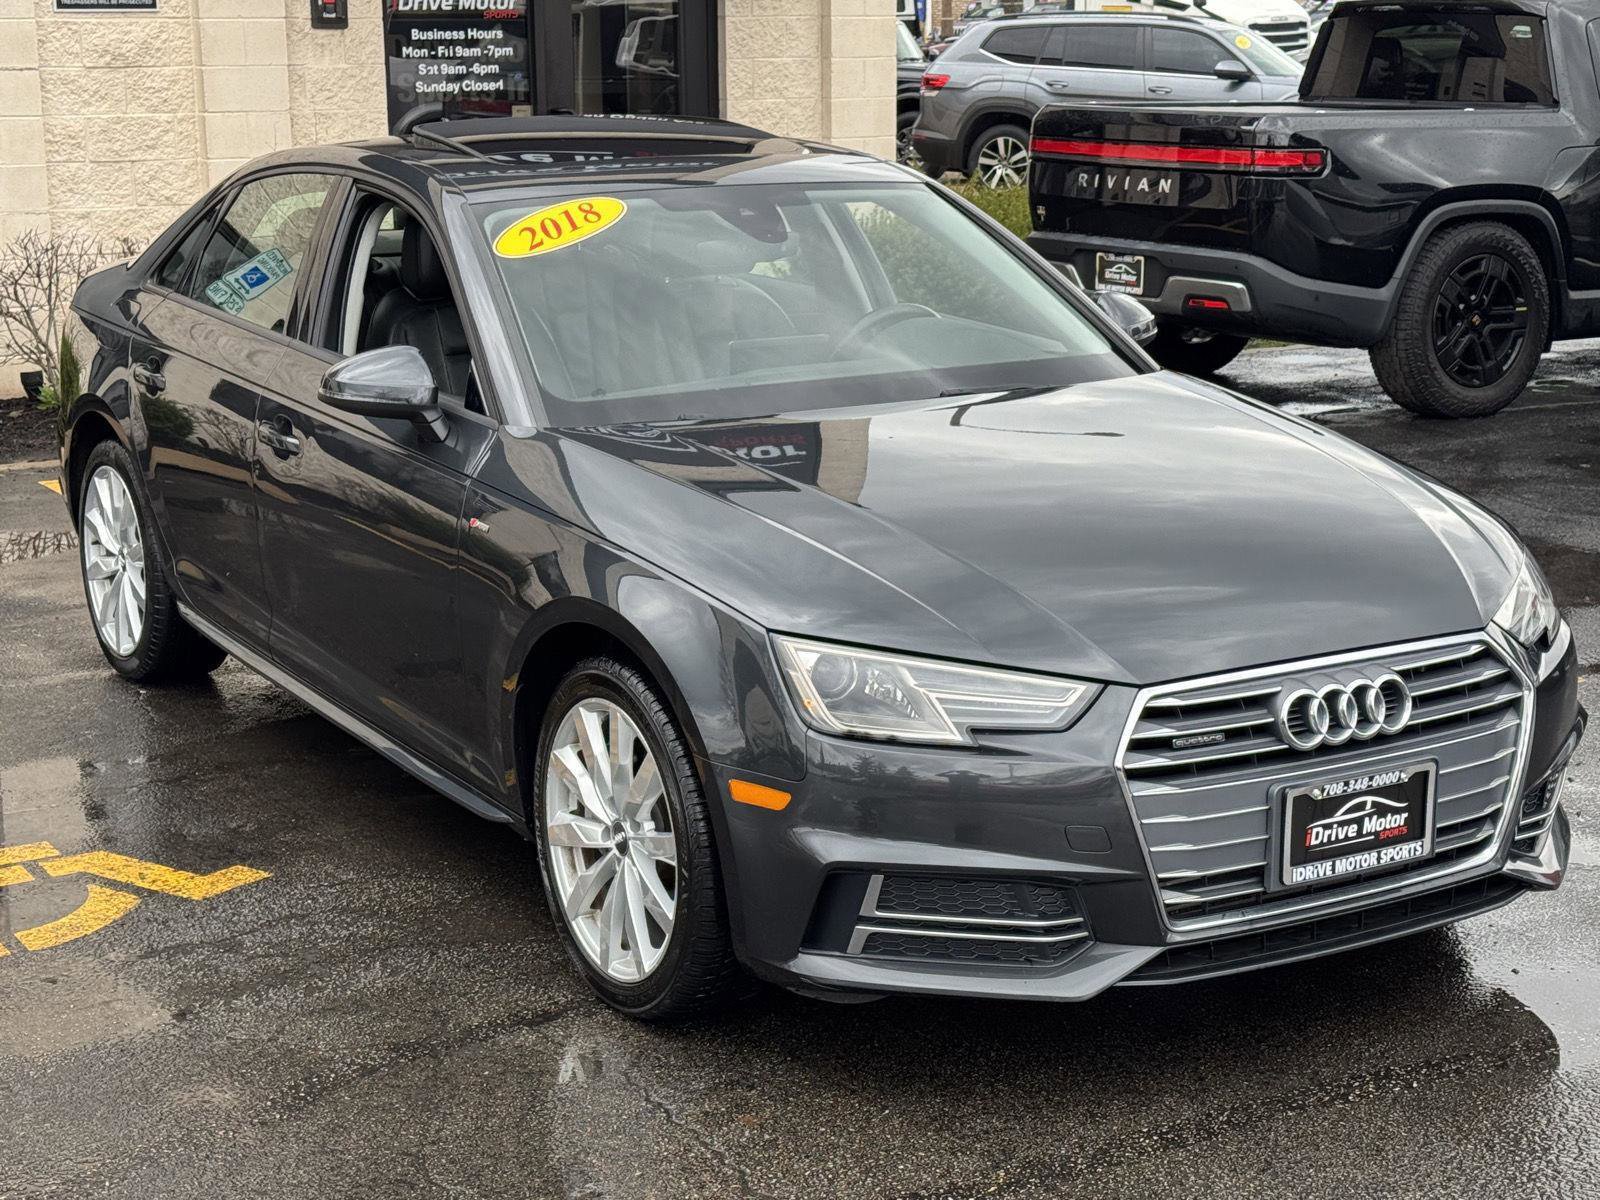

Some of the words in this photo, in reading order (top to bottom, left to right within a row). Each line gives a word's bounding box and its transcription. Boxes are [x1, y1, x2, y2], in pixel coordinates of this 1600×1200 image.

[483, 9, 519, 20] SPORTS
[411, 28, 465, 41] Business
[467, 28, 504, 40] Hours
[402, 46, 429, 58] Mon
[437, 46, 453, 57] Fri
[455, 45, 481, 57] 9am
[418, 63, 439, 75] Sat
[441, 62, 467, 74] 9am
[415, 80, 460, 94] Sunday
[462, 79, 504, 91] Closed
[1078, 172, 1172, 194] RIVIAN
[519, 202, 602, 251] 2018
[1322, 770, 1400, 797] 708-348-0000
[1304, 822, 1357, 849] iDrive
[1362, 811, 1409, 835] Motor
[1379, 825, 1409, 840] SPORTS
[1335, 852, 1378, 875] MOTOR
[1380, 841, 1423, 864] SPORTS
